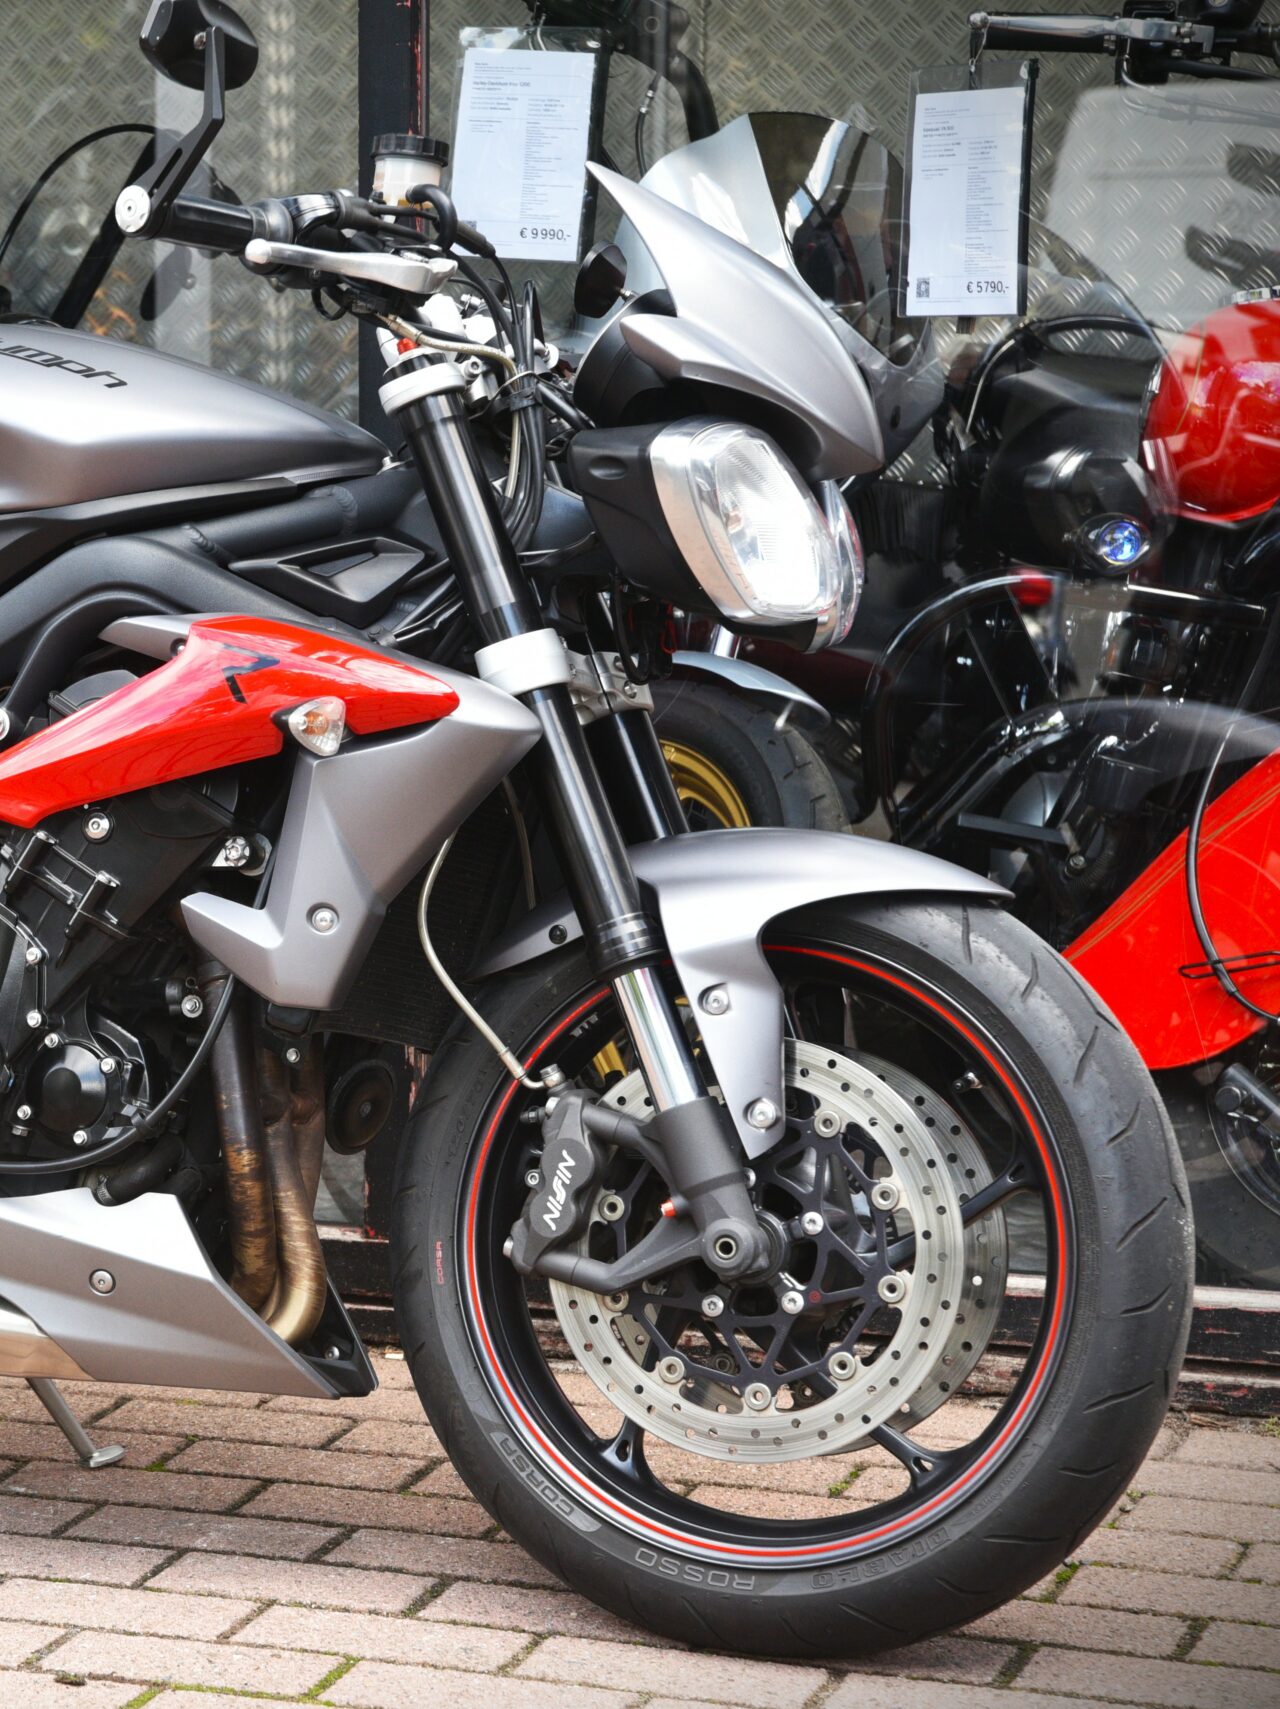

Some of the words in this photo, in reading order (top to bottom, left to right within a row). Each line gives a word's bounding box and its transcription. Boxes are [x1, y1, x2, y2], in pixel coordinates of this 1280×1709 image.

[519, 227, 528, 239] €
[966, 281, 974, 294] €
[434, 1240, 445, 1286] CORSA
[498, 1436, 575, 1518] CORSA
[634, 1546, 757, 1592] ROSSO
[809, 1525, 954, 1590] DIABLO
